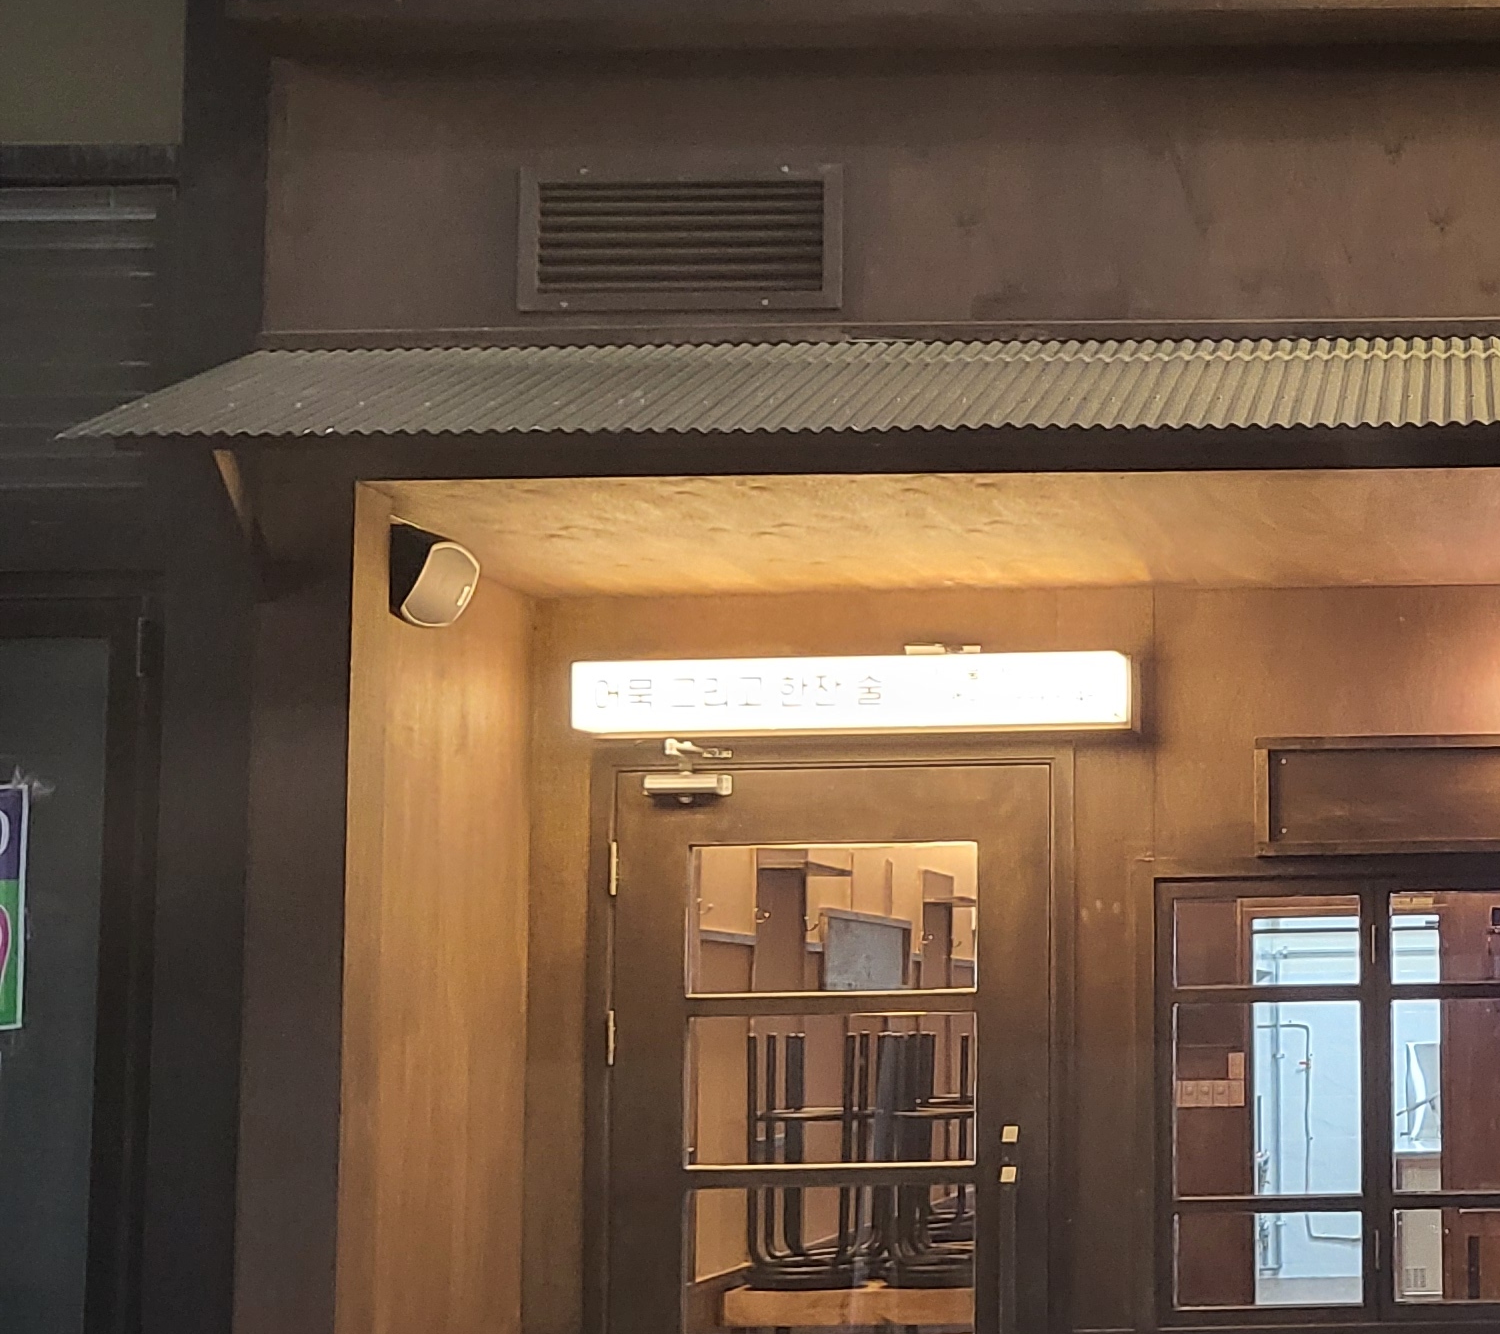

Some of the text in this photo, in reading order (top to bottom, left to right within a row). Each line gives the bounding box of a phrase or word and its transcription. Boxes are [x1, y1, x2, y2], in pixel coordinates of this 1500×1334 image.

[594, 674, 882, 709] 어묵 그리고 한잔 술
